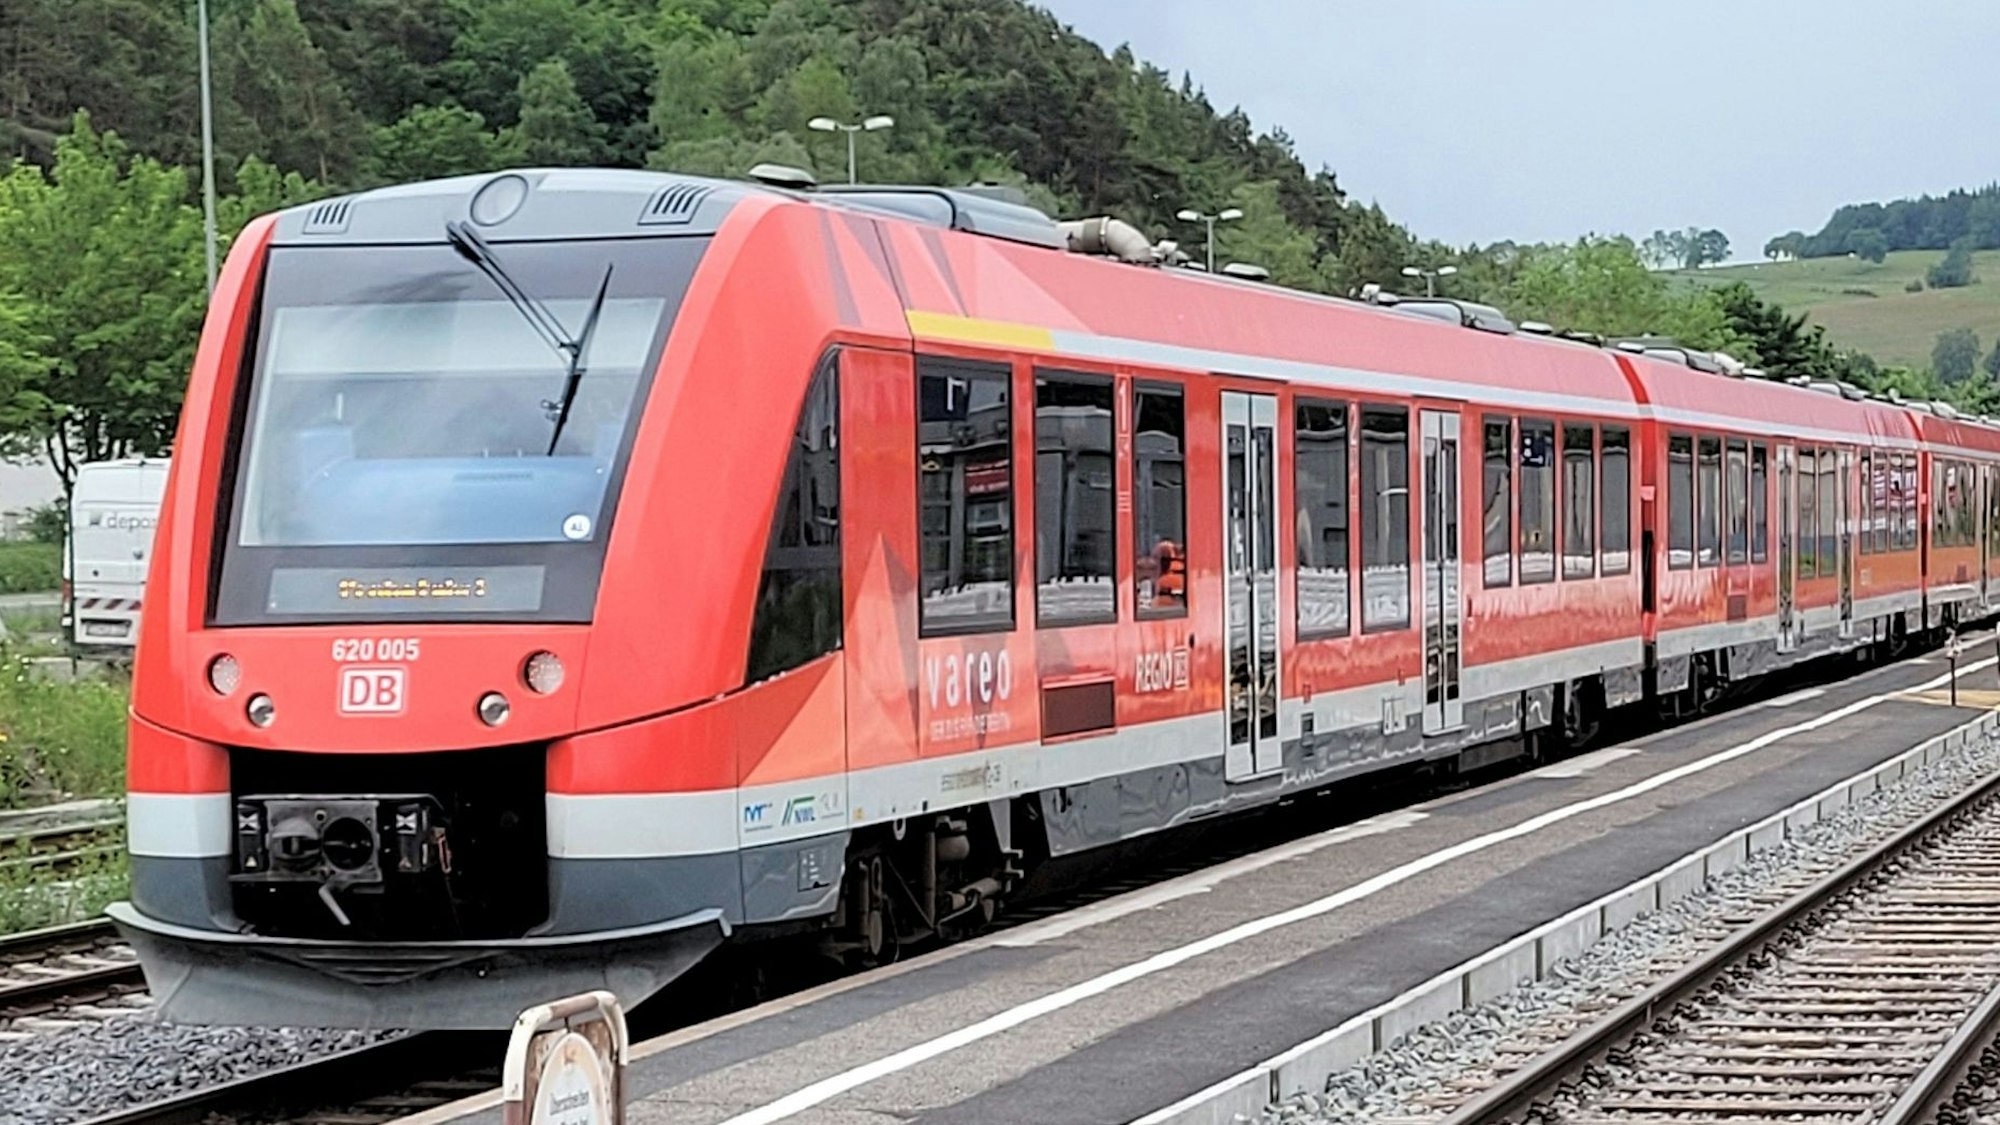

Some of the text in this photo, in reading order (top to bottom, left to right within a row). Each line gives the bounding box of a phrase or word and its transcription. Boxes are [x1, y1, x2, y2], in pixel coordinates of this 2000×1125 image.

[106, 511, 157, 532] depo
[332, 638, 420, 661] 620 005
[348, 672, 399, 707] DB
[926, 649, 1012, 711] vareo
[1135, 651, 1173, 693] REGIO
